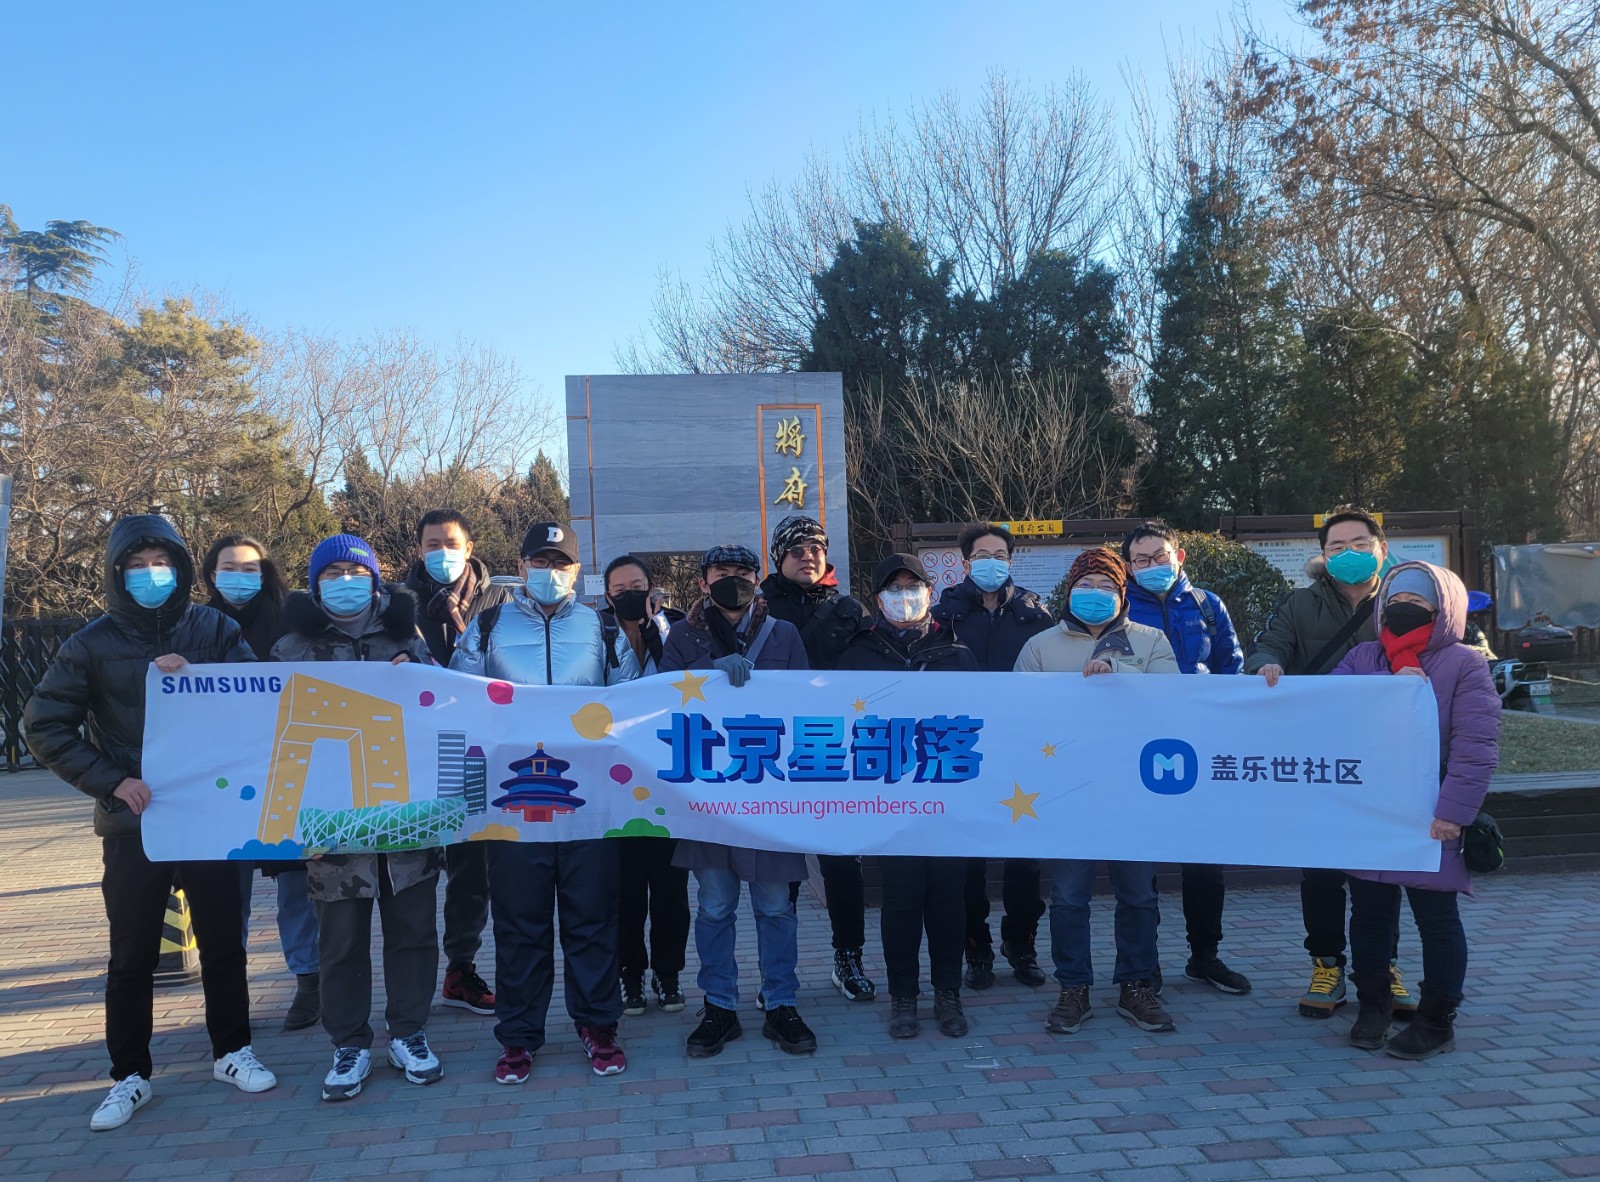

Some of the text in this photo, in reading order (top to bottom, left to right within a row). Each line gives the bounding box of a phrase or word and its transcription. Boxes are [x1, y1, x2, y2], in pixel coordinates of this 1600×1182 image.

[546, 526, 564, 543] D
[161, 675, 282, 694] SAMSUNG
[656, 712, 984, 784] 北京星部落
[1210, 754, 1363, 785] 盖乐世社区
[688, 795, 945, 820] www.samsungmembers.cn
